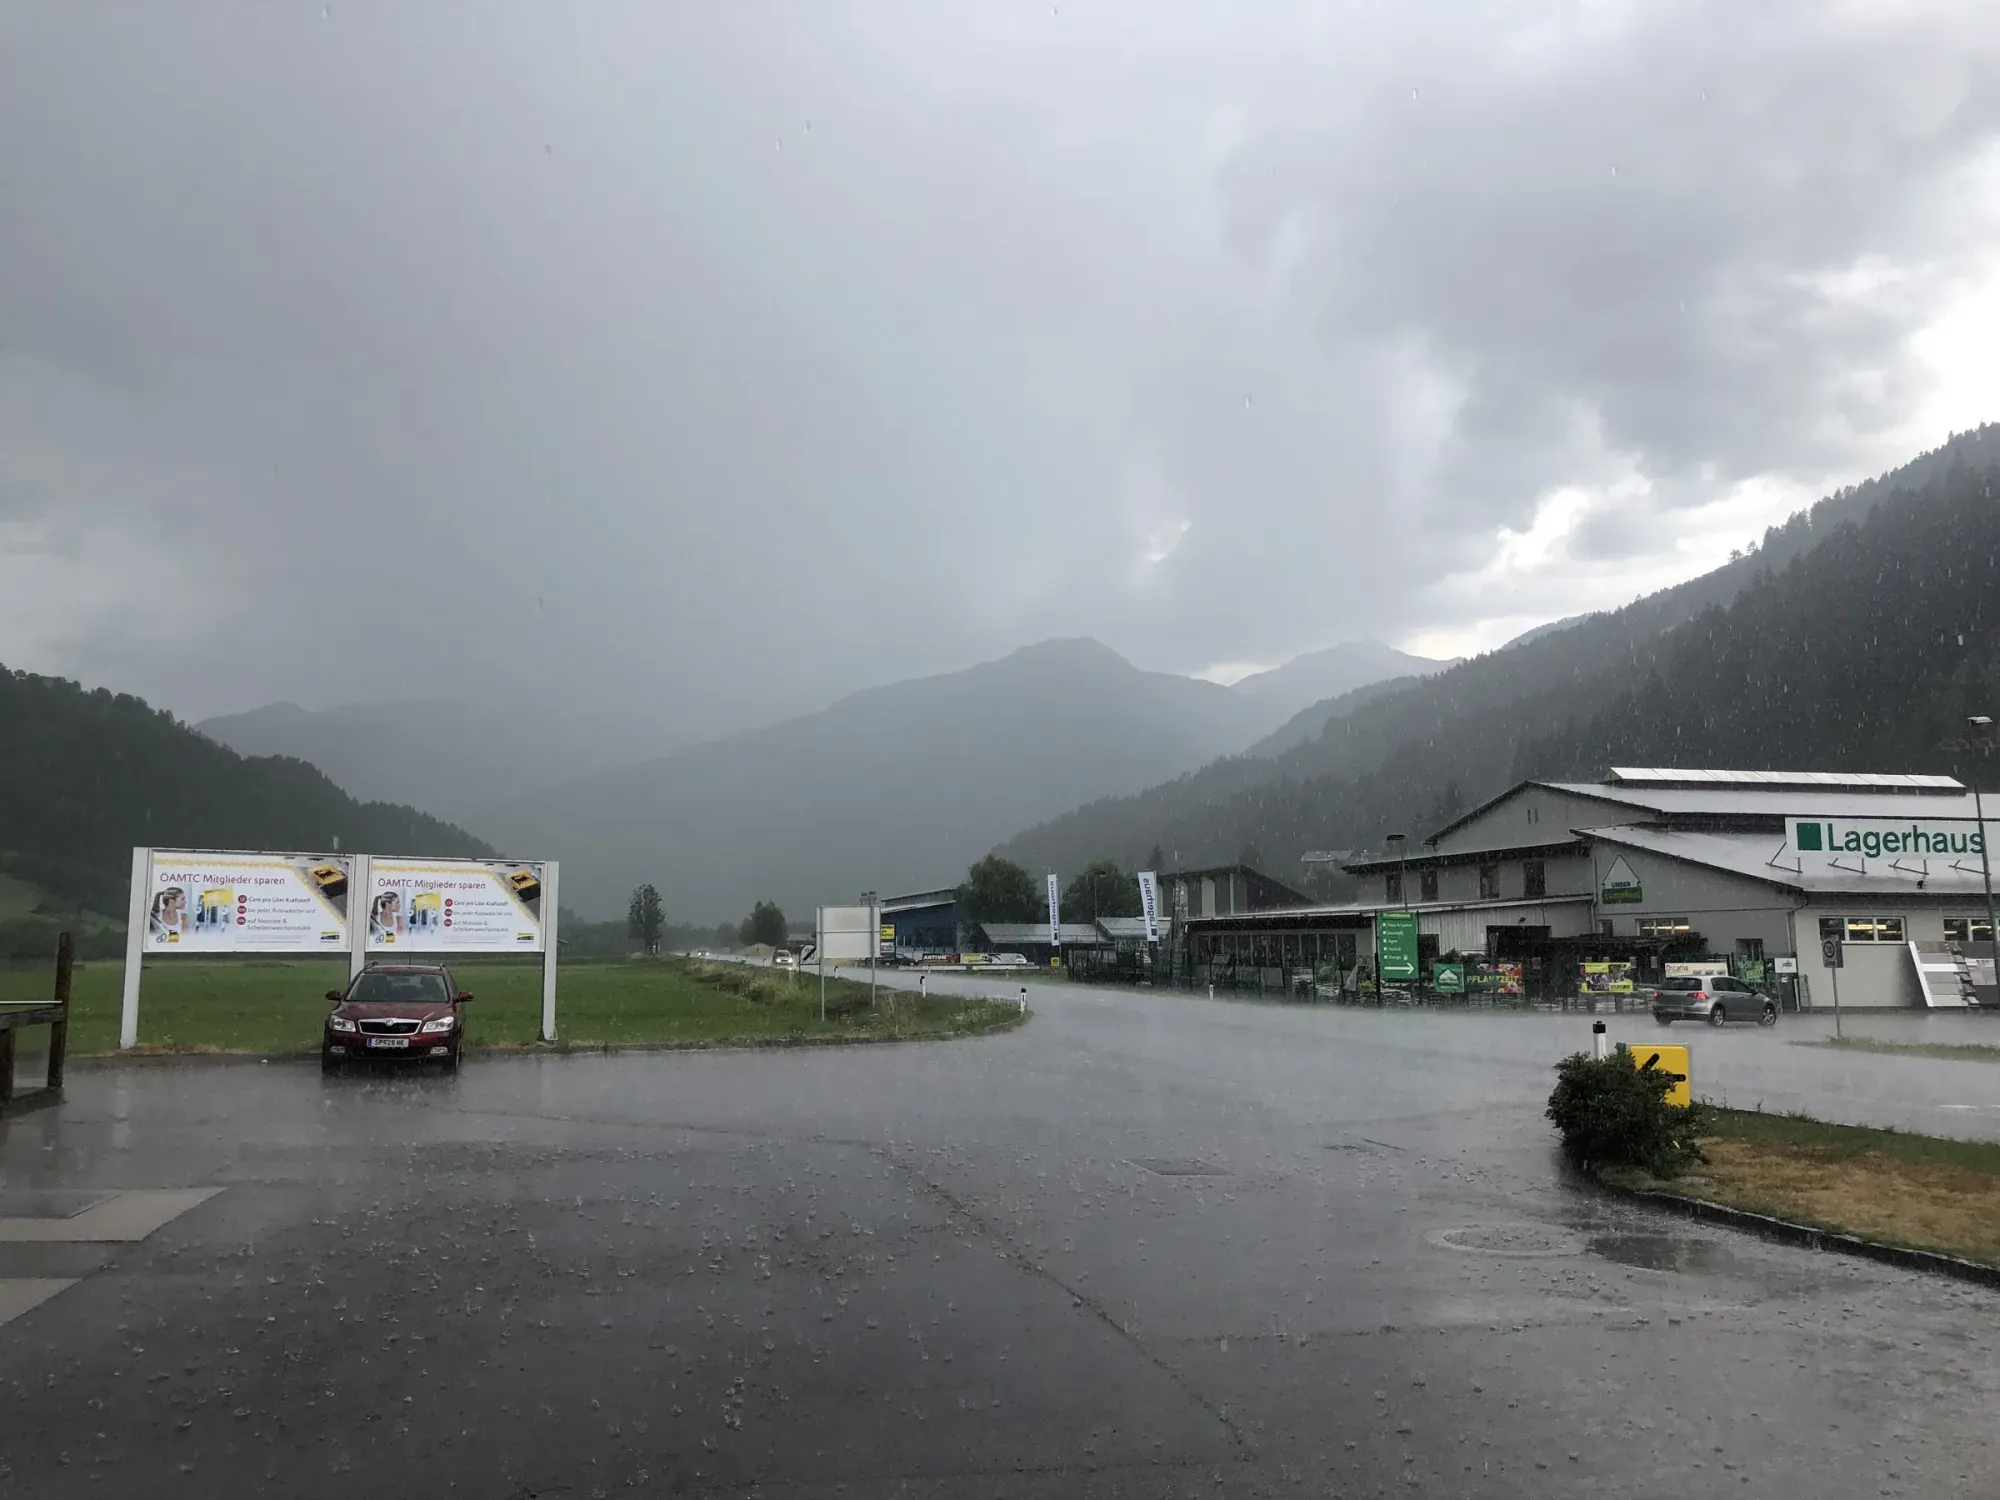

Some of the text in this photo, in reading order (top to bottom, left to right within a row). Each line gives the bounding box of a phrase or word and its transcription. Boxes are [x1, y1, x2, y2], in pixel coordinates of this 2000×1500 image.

[1827, 823, 1984, 858] Lagerhaus
[160, 872, 285, 887] ÖAMTC Mitglieder sparen
[414, 879, 457, 890] Mitglieder
[459, 882, 486, 891] sparen
